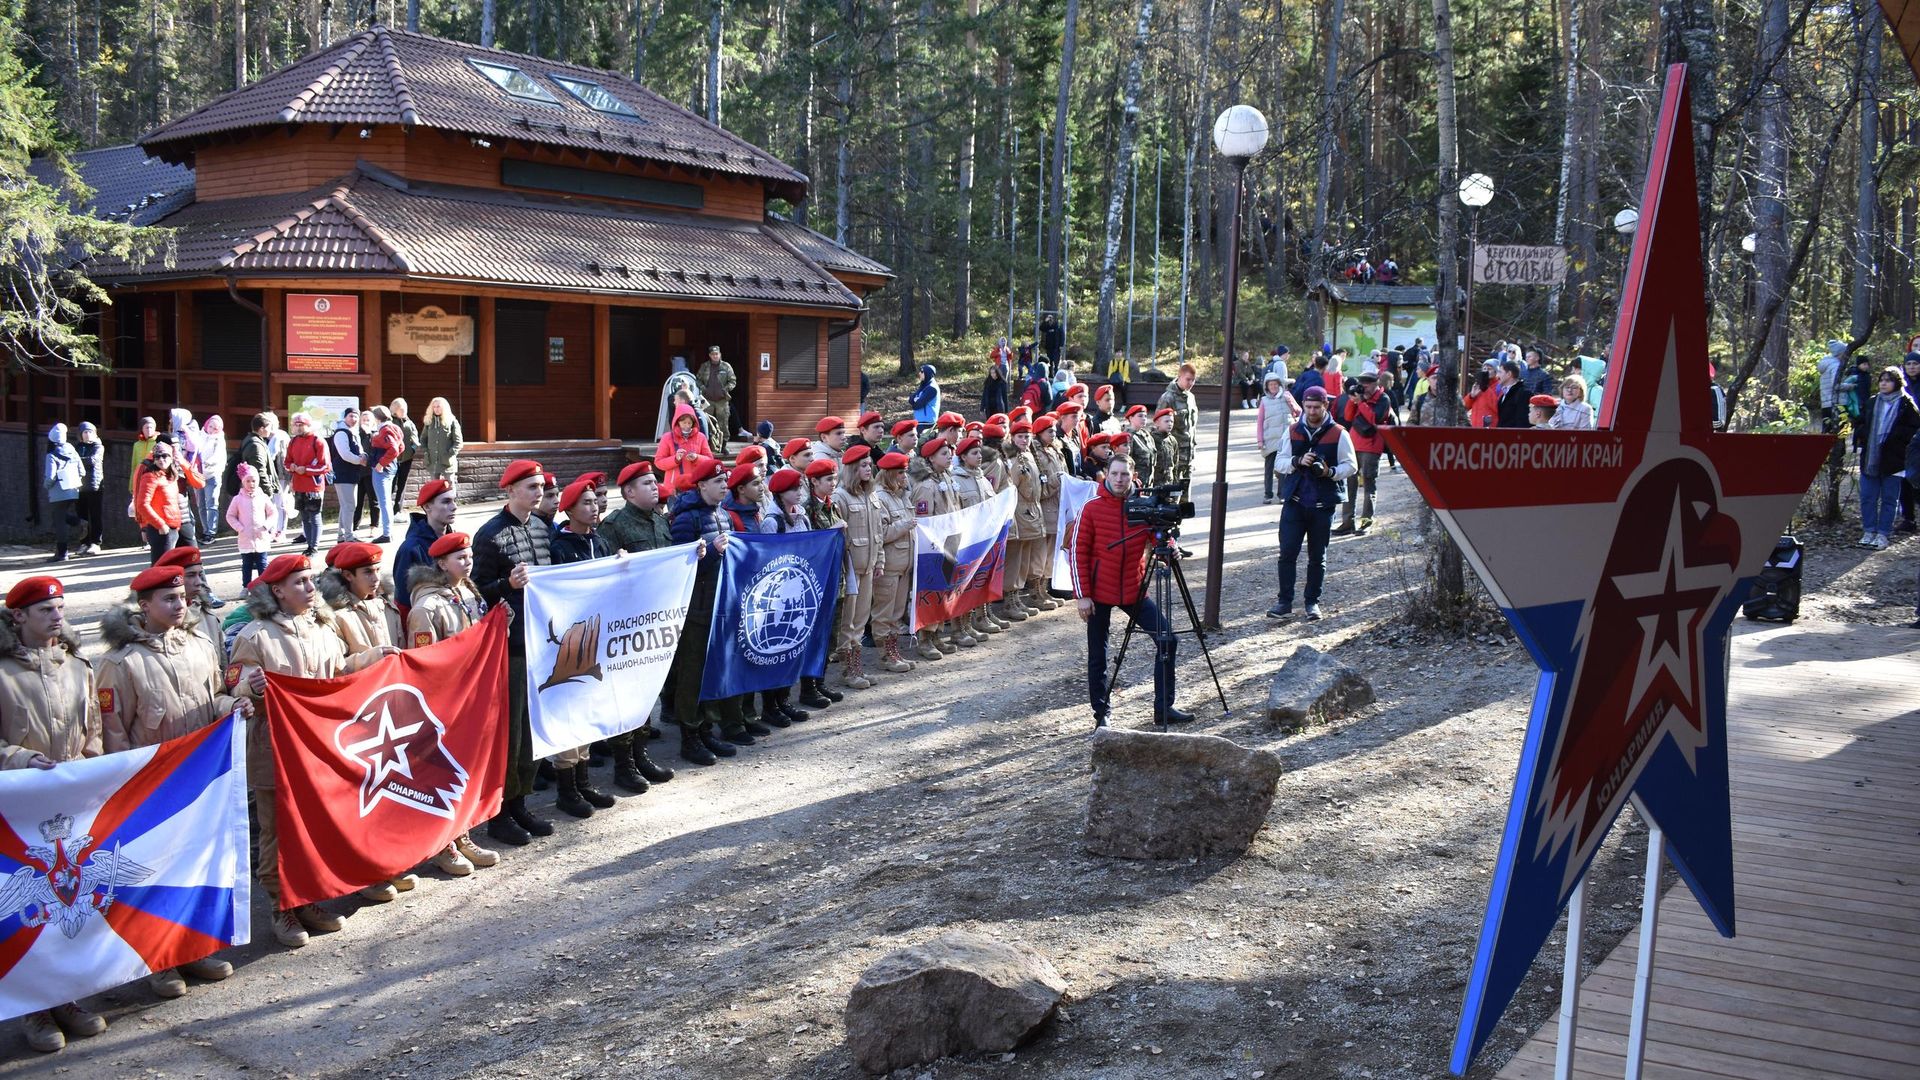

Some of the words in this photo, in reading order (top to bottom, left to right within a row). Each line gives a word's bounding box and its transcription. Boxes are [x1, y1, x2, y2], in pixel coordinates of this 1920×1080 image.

[1484, 260, 1554, 282] СТОЛБЫ
[1429, 436, 1578, 470] КРАСНОЯРСКИЙ
[1582, 437, 1624, 469] КРАЙ
[607, 606, 687, 633] КРАСНОЯРСКИЕ
[607, 650, 672, 672] НАЦИОНАЛЬНЫЙ
[743, 649, 778, 665] ОСНОВАНО
[1596, 698, 1665, 810] ЮНАРМИЯ
[387, 781, 434, 804] ЮНАРМИЯ
